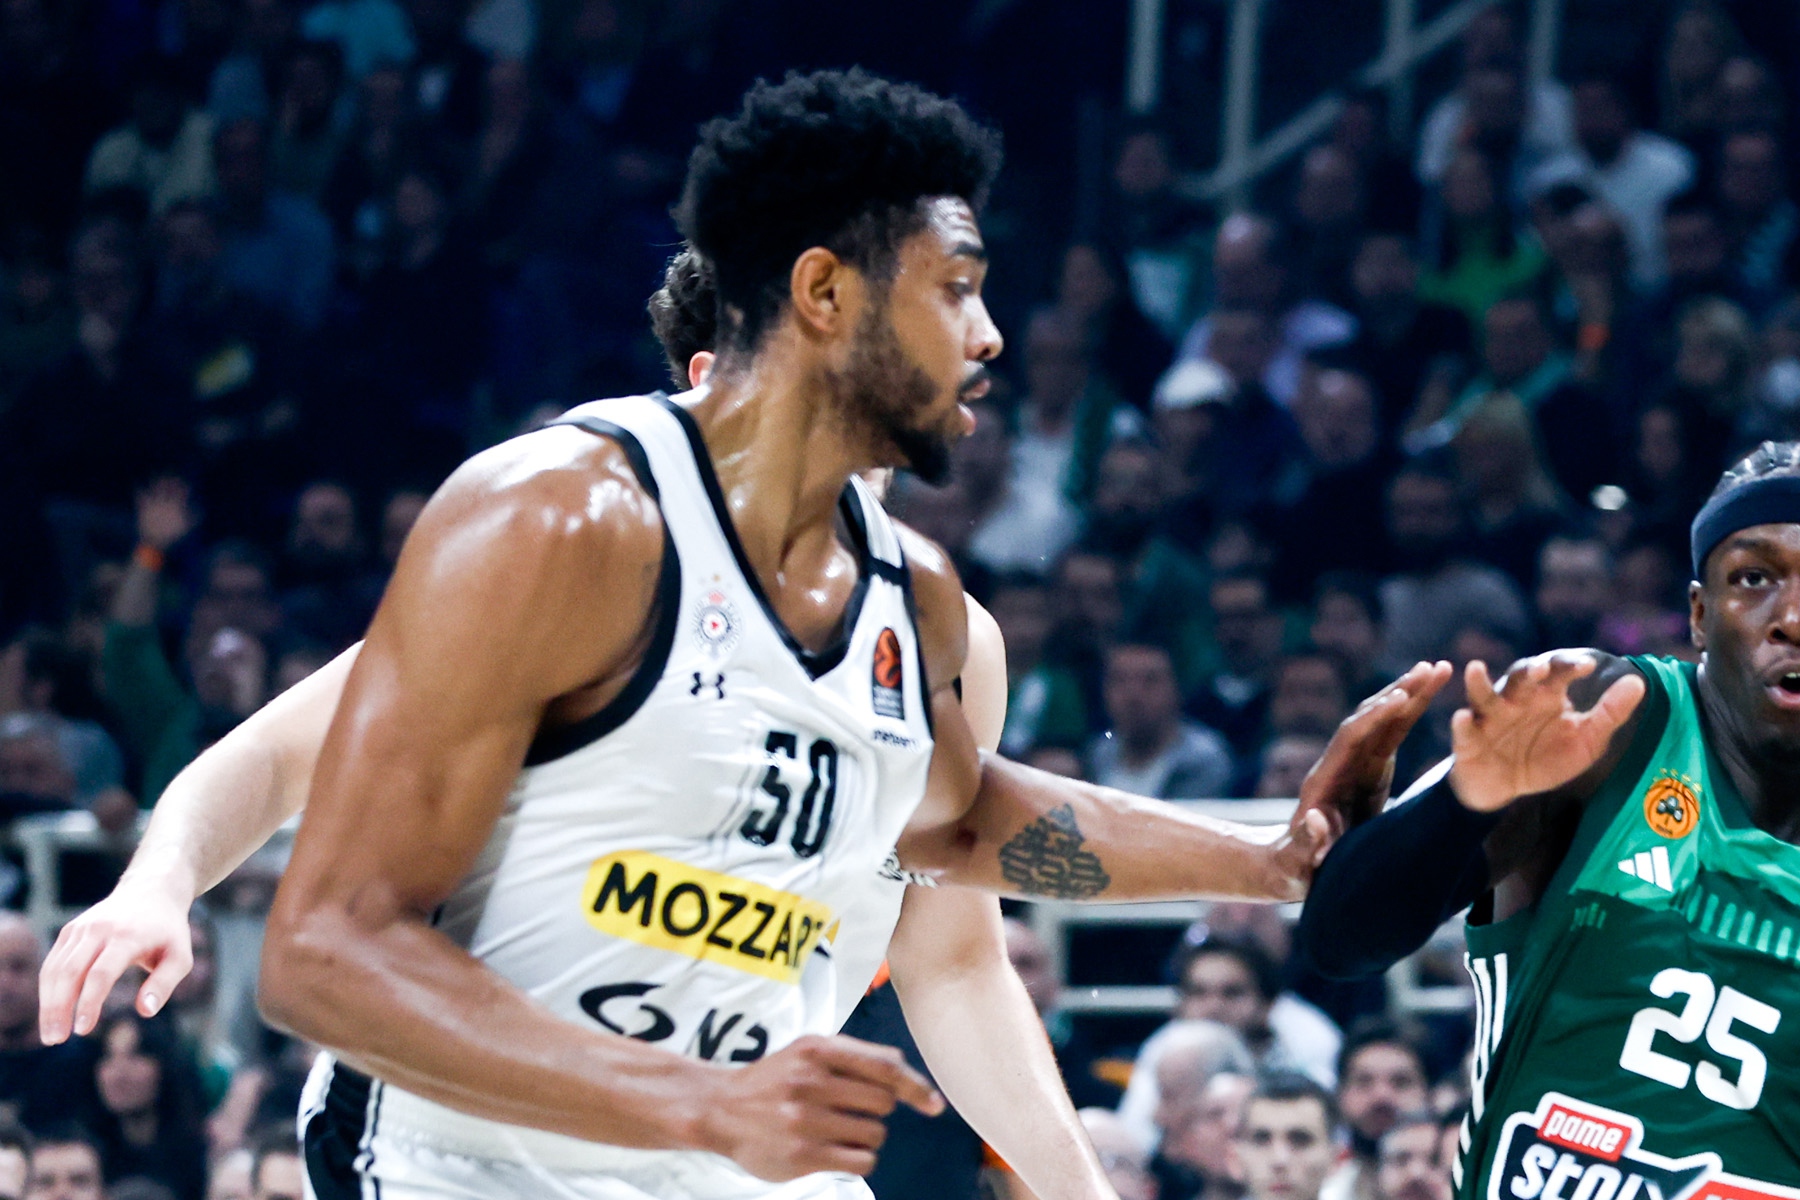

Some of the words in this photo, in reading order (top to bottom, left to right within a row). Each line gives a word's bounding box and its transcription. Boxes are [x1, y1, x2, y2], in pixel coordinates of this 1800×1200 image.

[740, 730, 838, 858] 50
[1619, 967, 1782, 1110] 25
[1543, 1109, 1624, 1153] pame
